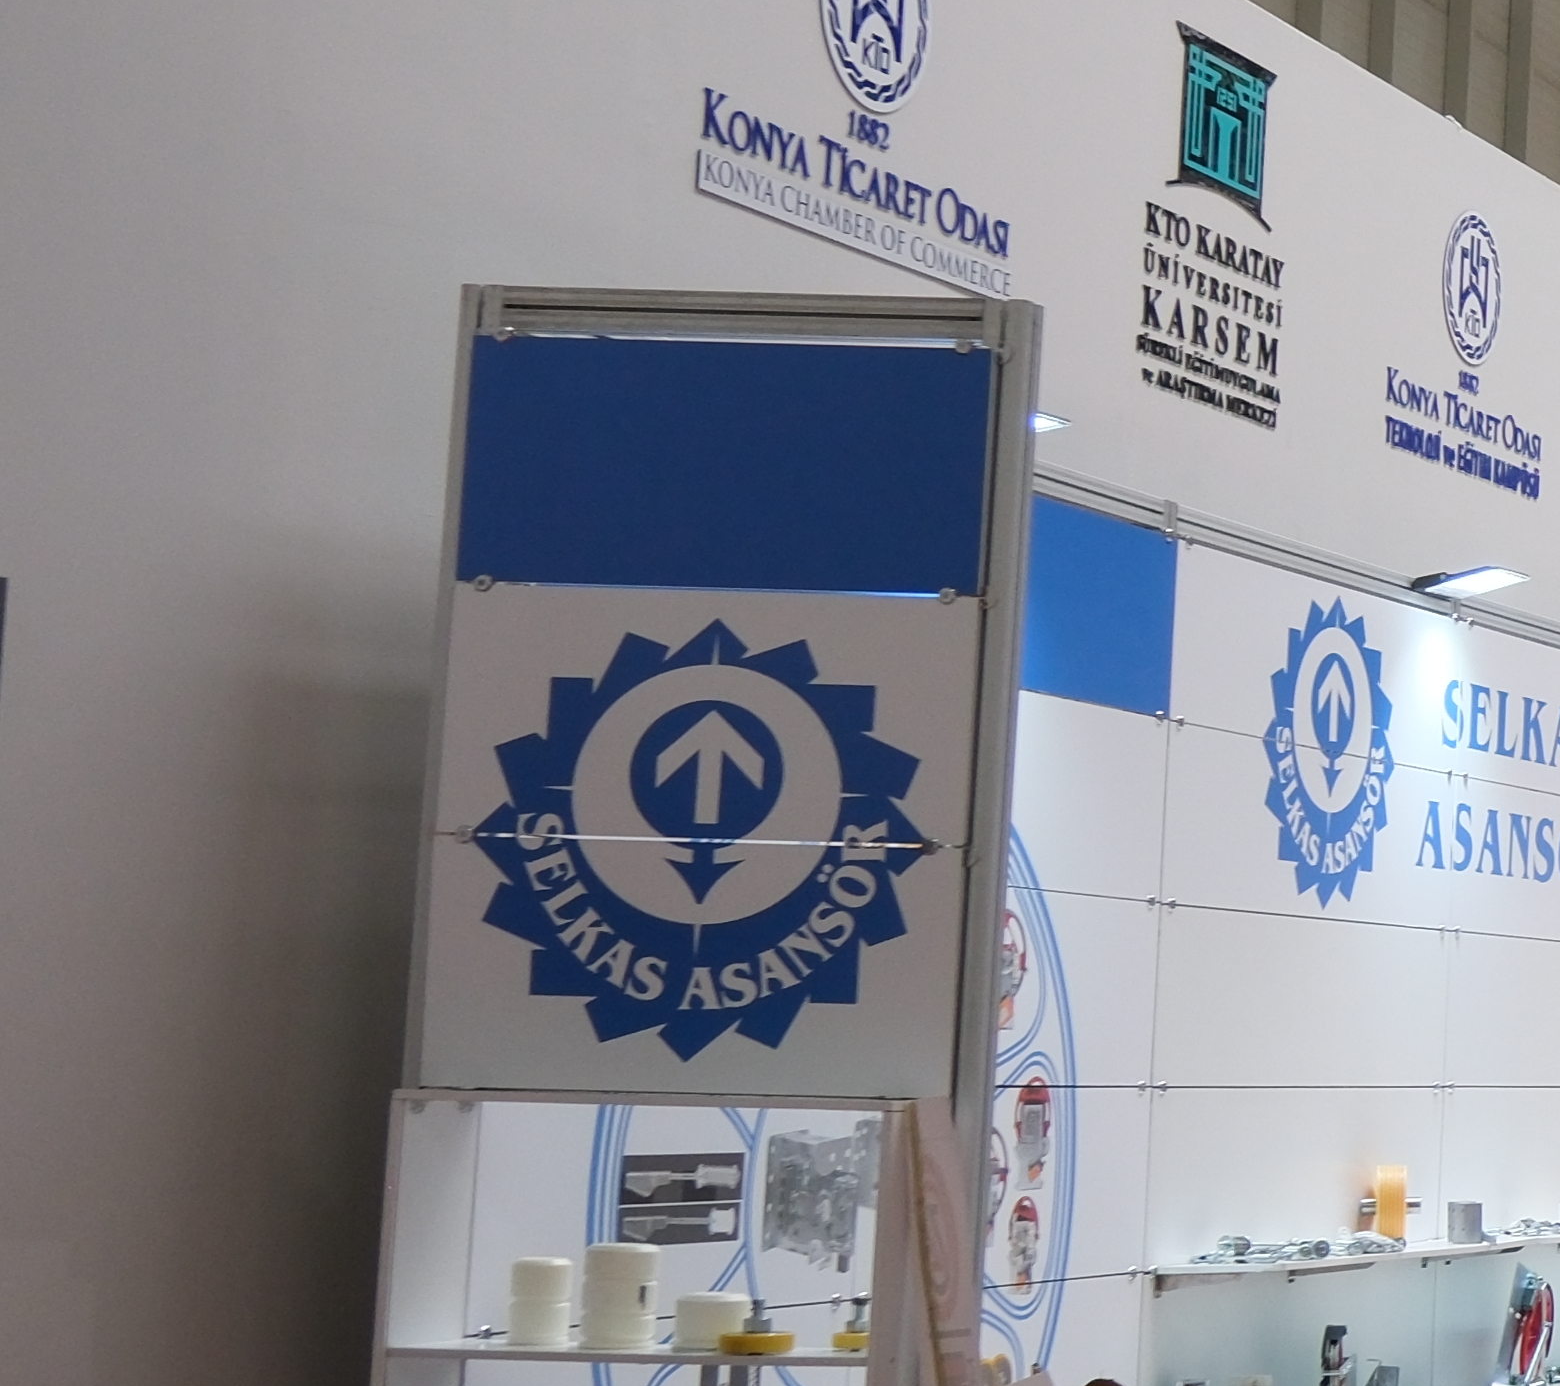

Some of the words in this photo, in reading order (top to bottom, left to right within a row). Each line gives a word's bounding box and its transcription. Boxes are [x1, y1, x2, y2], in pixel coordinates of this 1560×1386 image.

[702, 87, 811, 180] KONYA
[818, 134, 933, 226] TİCARET
[936, 188, 1010, 259] ODASI
[847, 110, 891, 152] 1882
[703, 154, 775, 207] KONYA
[780, 184, 877, 245] CHAMBER
[881, 224, 905, 255] OF
[910, 235, 1012, 297] COMMERCE
[1145, 201, 1191, 248] KTO
[1195, 223, 1285, 289] KARATAY
[1141, 284, 1279, 377] KARSEM
[1385, 366, 1440, 423] KONYA
[1443, 390, 1501, 445] TİCARET
[1502, 414, 1542, 462] ODASI
[1275, 726, 1321, 867] SELKAS
[1320, 745, 1386, 875] ASANSÖR
[515, 812, 668, 1003] SELKAS
[677, 819, 890, 1011] ASANSÖR
